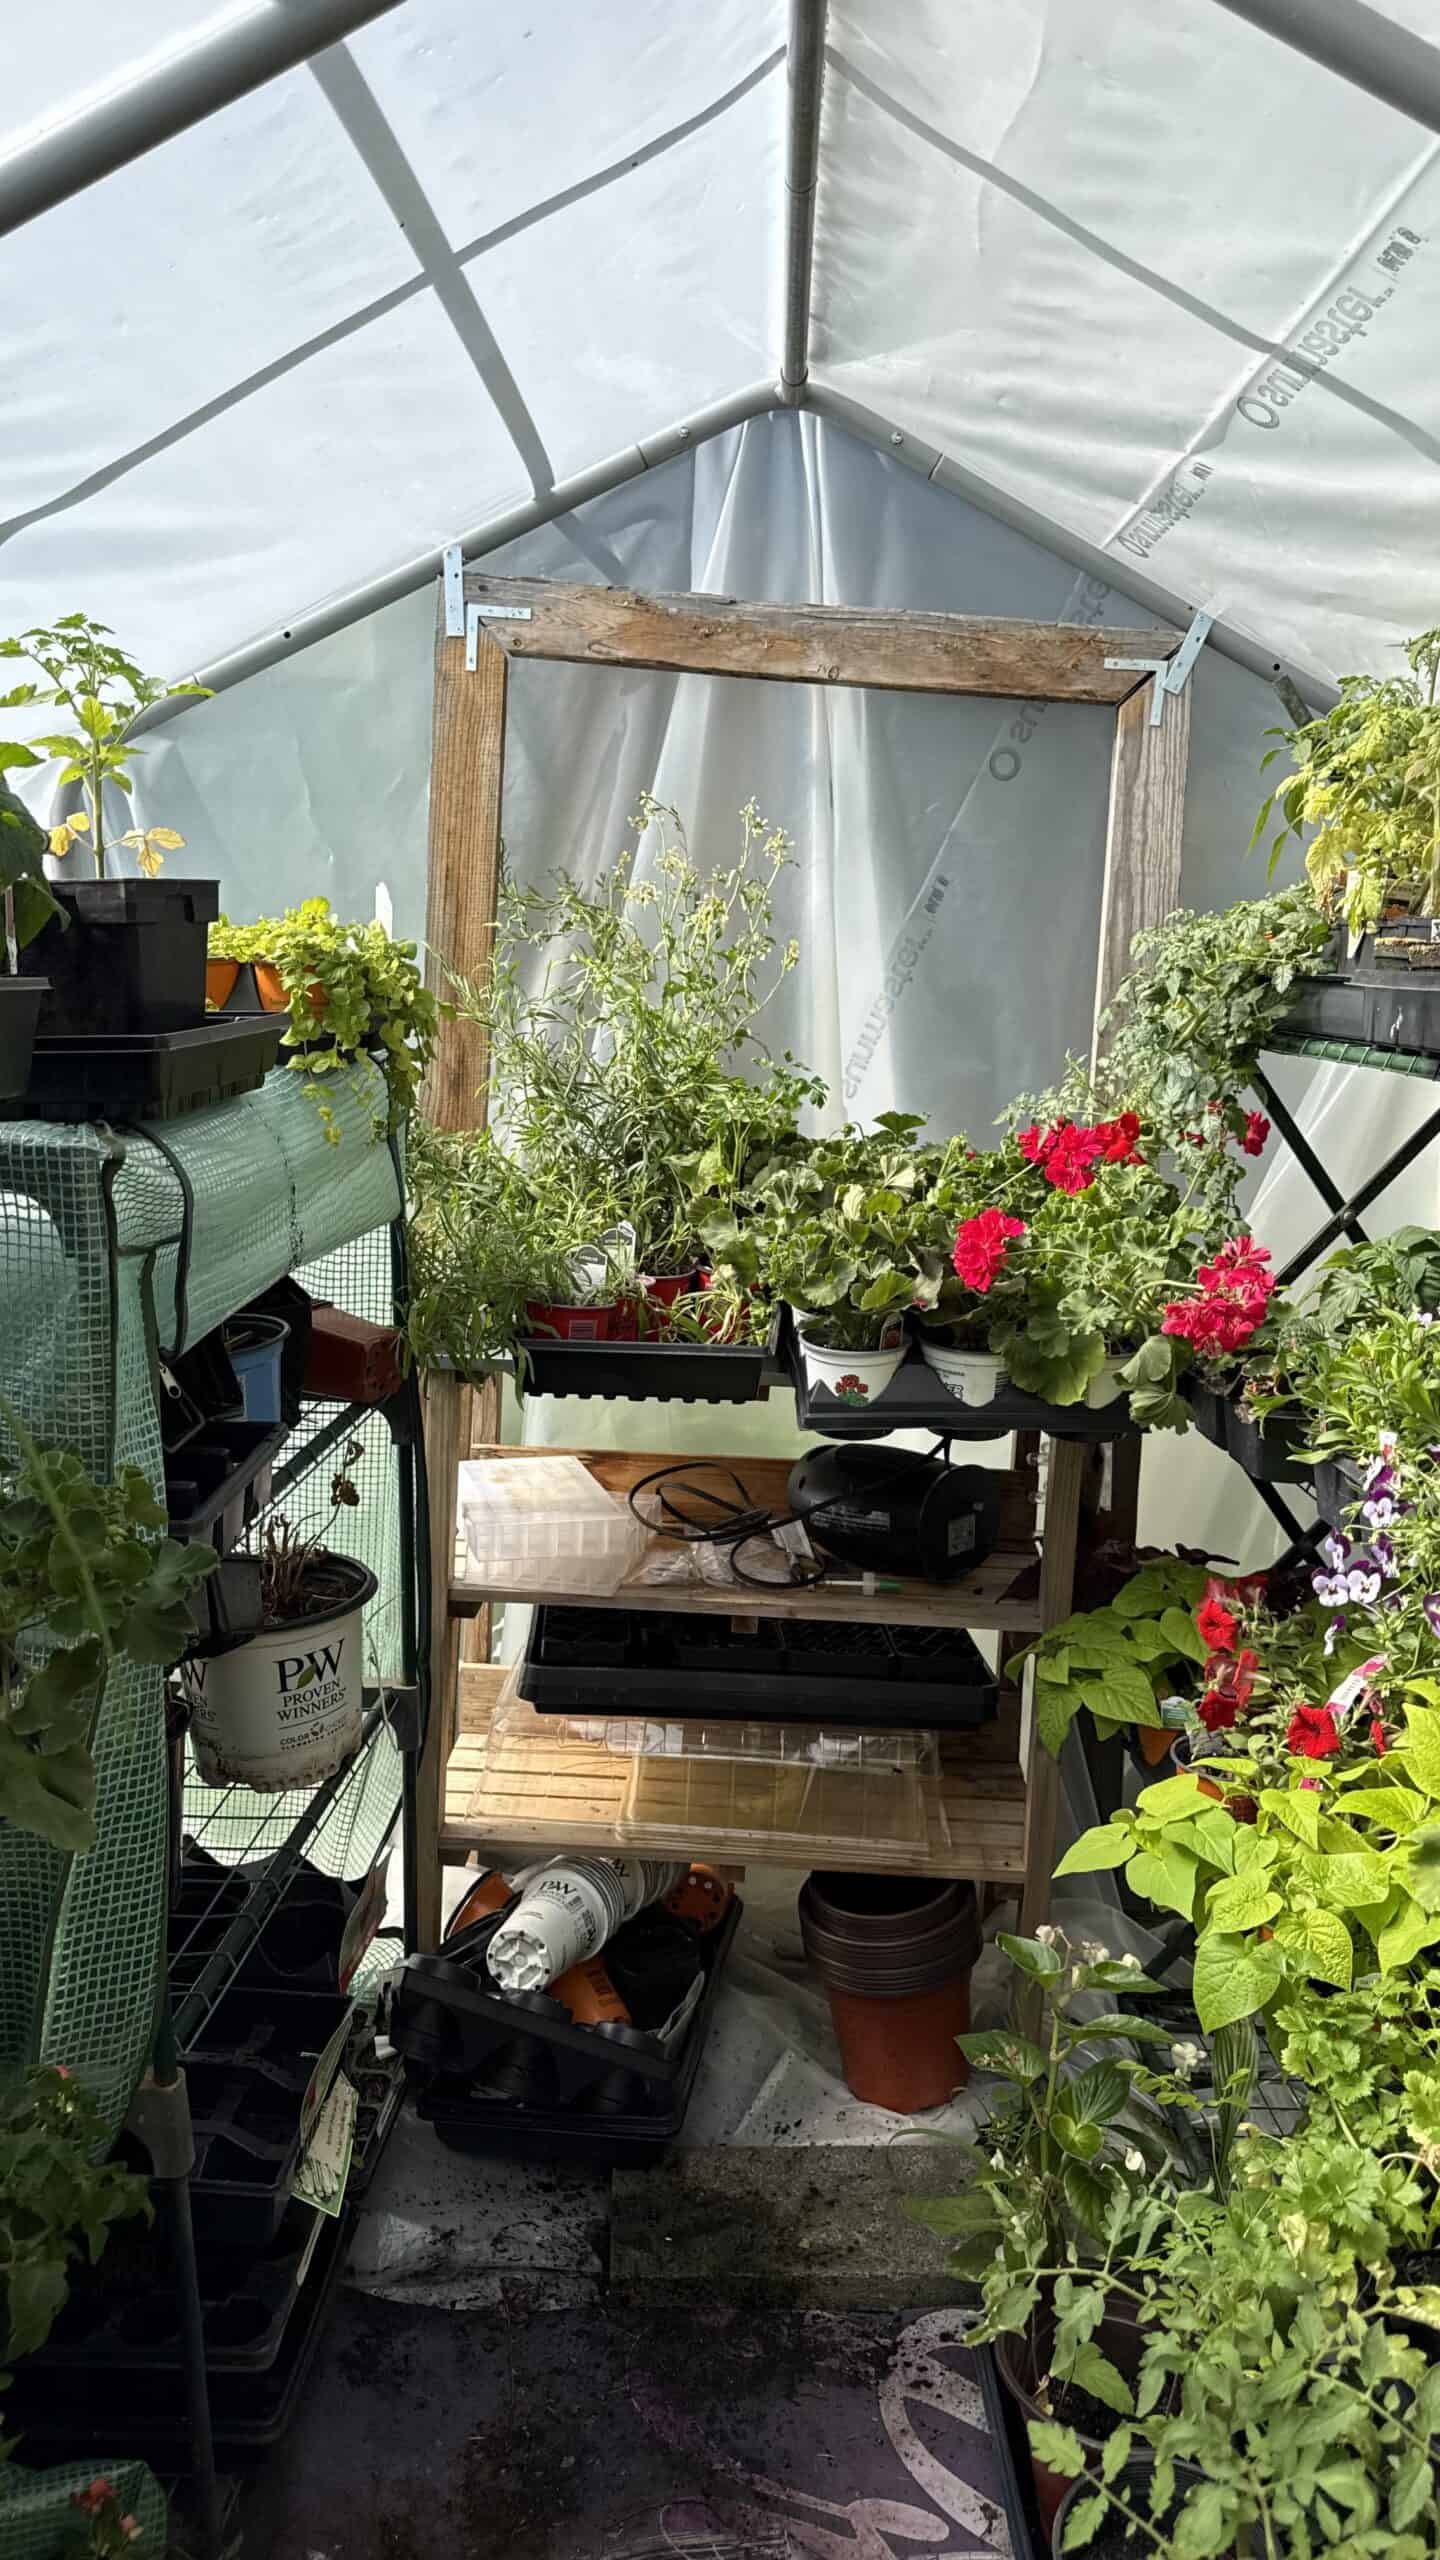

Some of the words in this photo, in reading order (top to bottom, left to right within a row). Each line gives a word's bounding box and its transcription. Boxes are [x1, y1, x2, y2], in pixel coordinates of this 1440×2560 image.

[272, 1638, 345, 1694] PW
[277, 1690, 346, 1721] WINNERS
[283, 1678, 341, 1708] PROVEN
